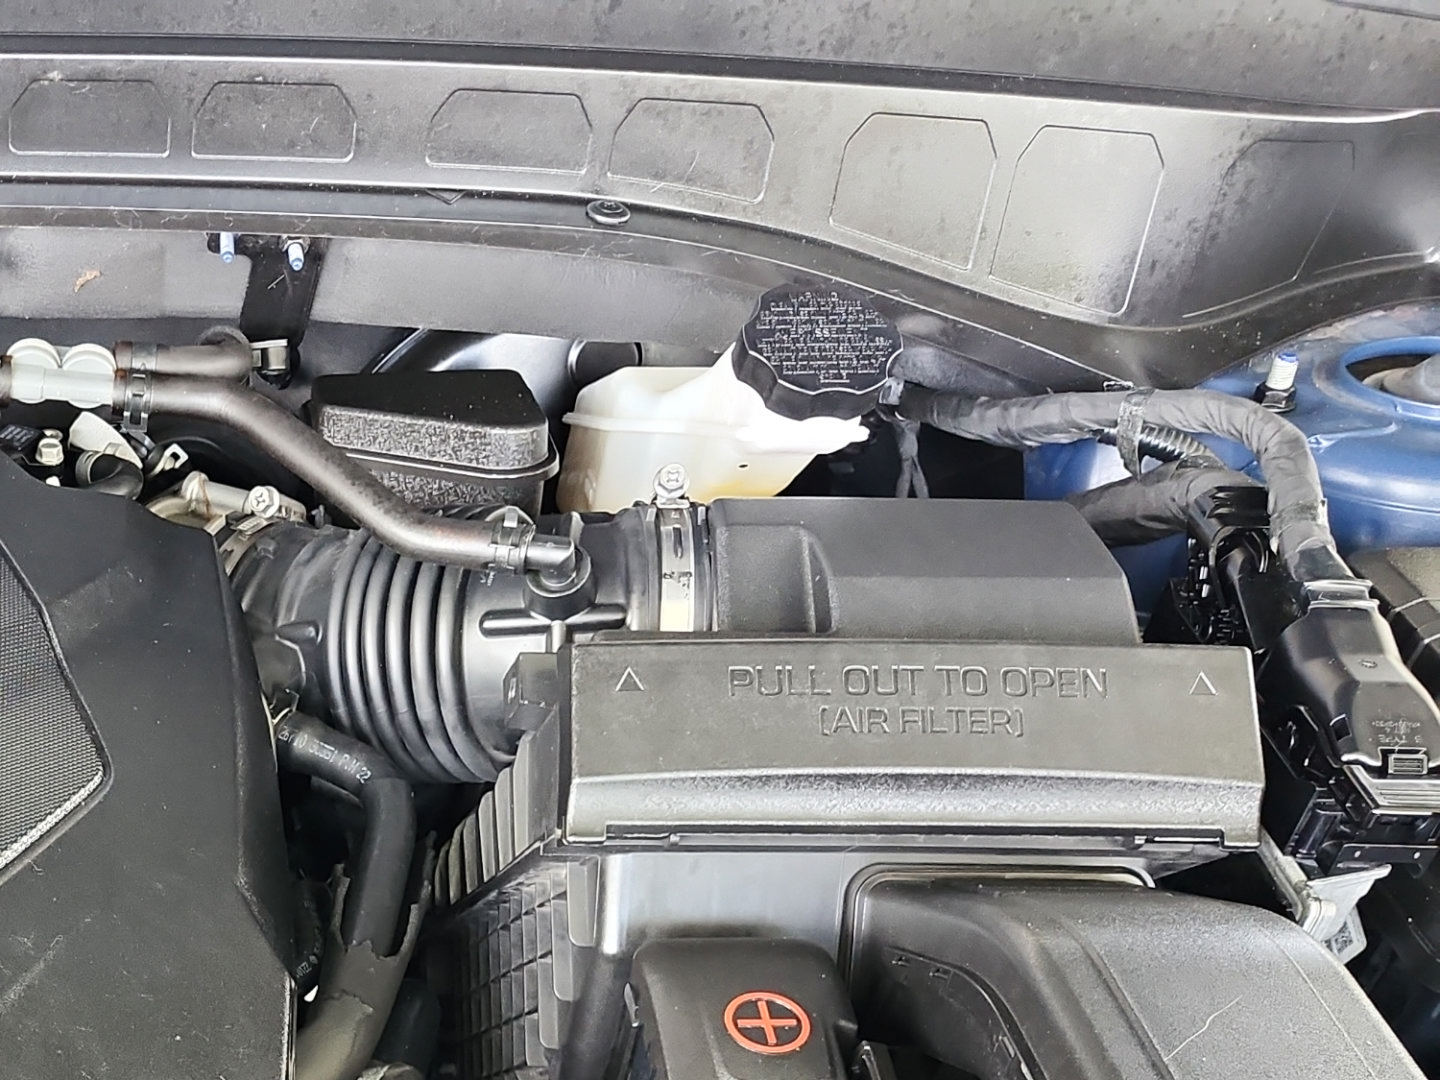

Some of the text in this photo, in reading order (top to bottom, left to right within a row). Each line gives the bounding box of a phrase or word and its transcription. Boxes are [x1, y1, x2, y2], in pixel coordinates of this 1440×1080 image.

[728, 664, 1109, 699] PULL OUT TO OPEN
